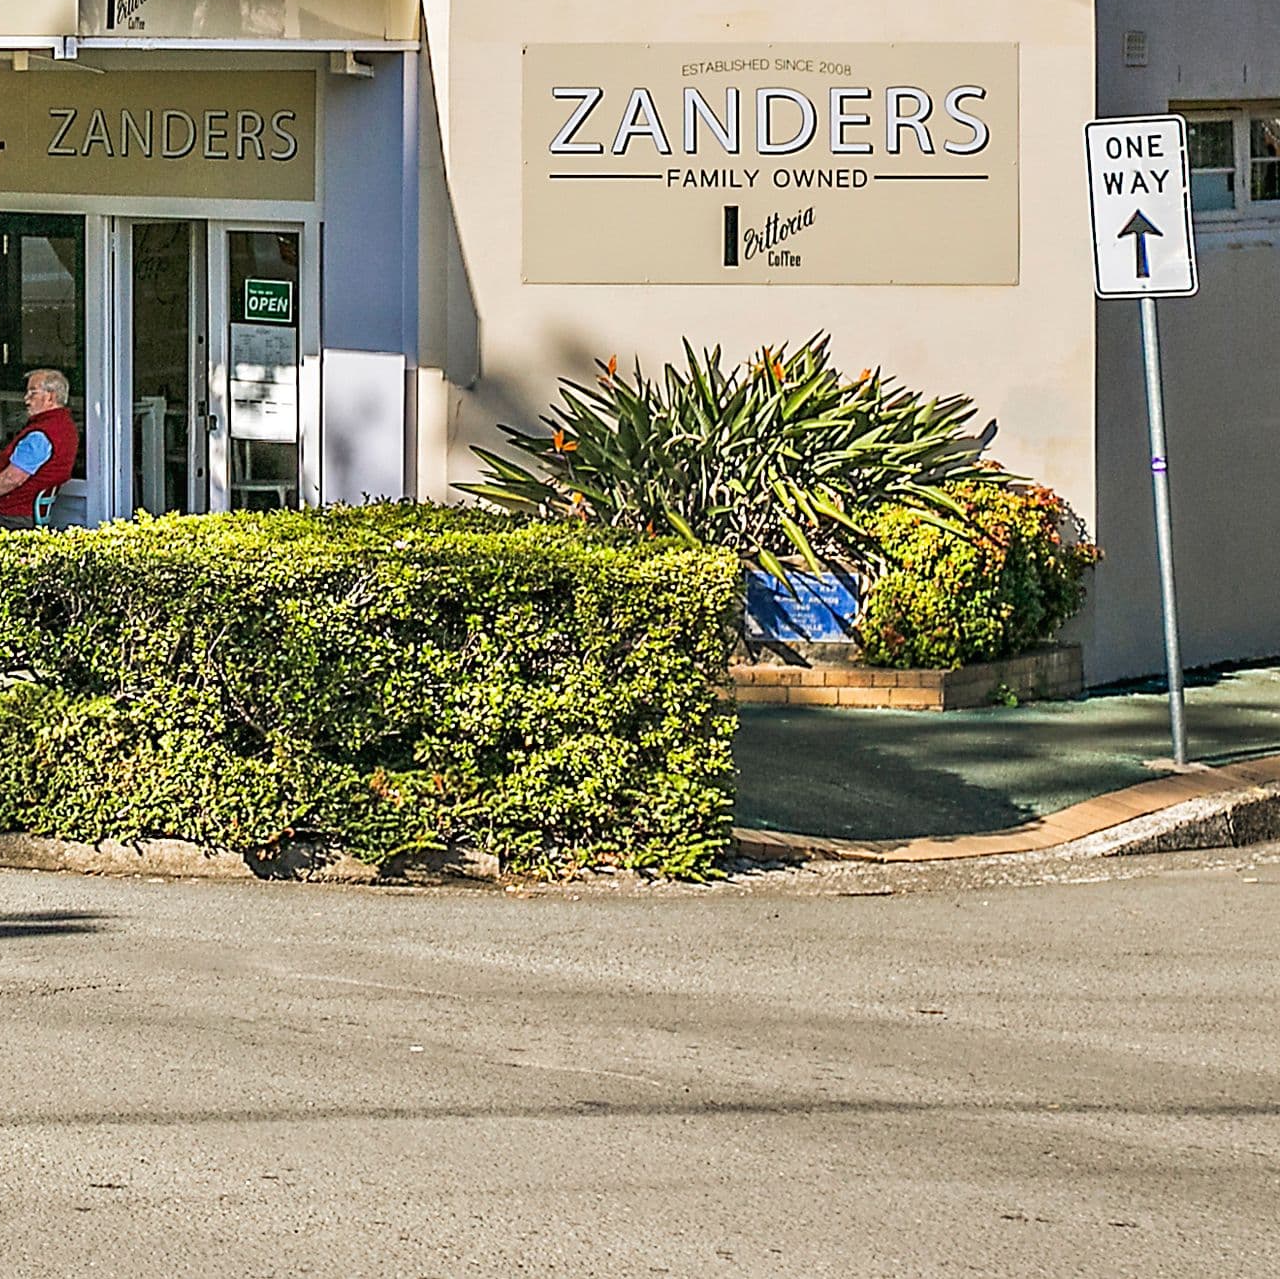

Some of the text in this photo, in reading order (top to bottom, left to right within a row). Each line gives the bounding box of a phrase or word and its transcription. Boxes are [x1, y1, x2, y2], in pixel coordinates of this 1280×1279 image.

[682, 58, 852, 77] ESTABLISHED SINCE 2008
[549, 85, 990, 156] ZANDERS
[47, 107, 299, 161] ZANDERS
[1105, 134, 1164, 160] ONE
[666, 168, 869, 189] FAMILY OWNED
[1103, 169, 1170, 196] WAY
[743, 207, 814, 260] Vittoria
[767, 249, 801, 267] Coffee
[248, 296, 288, 312] OPEN
